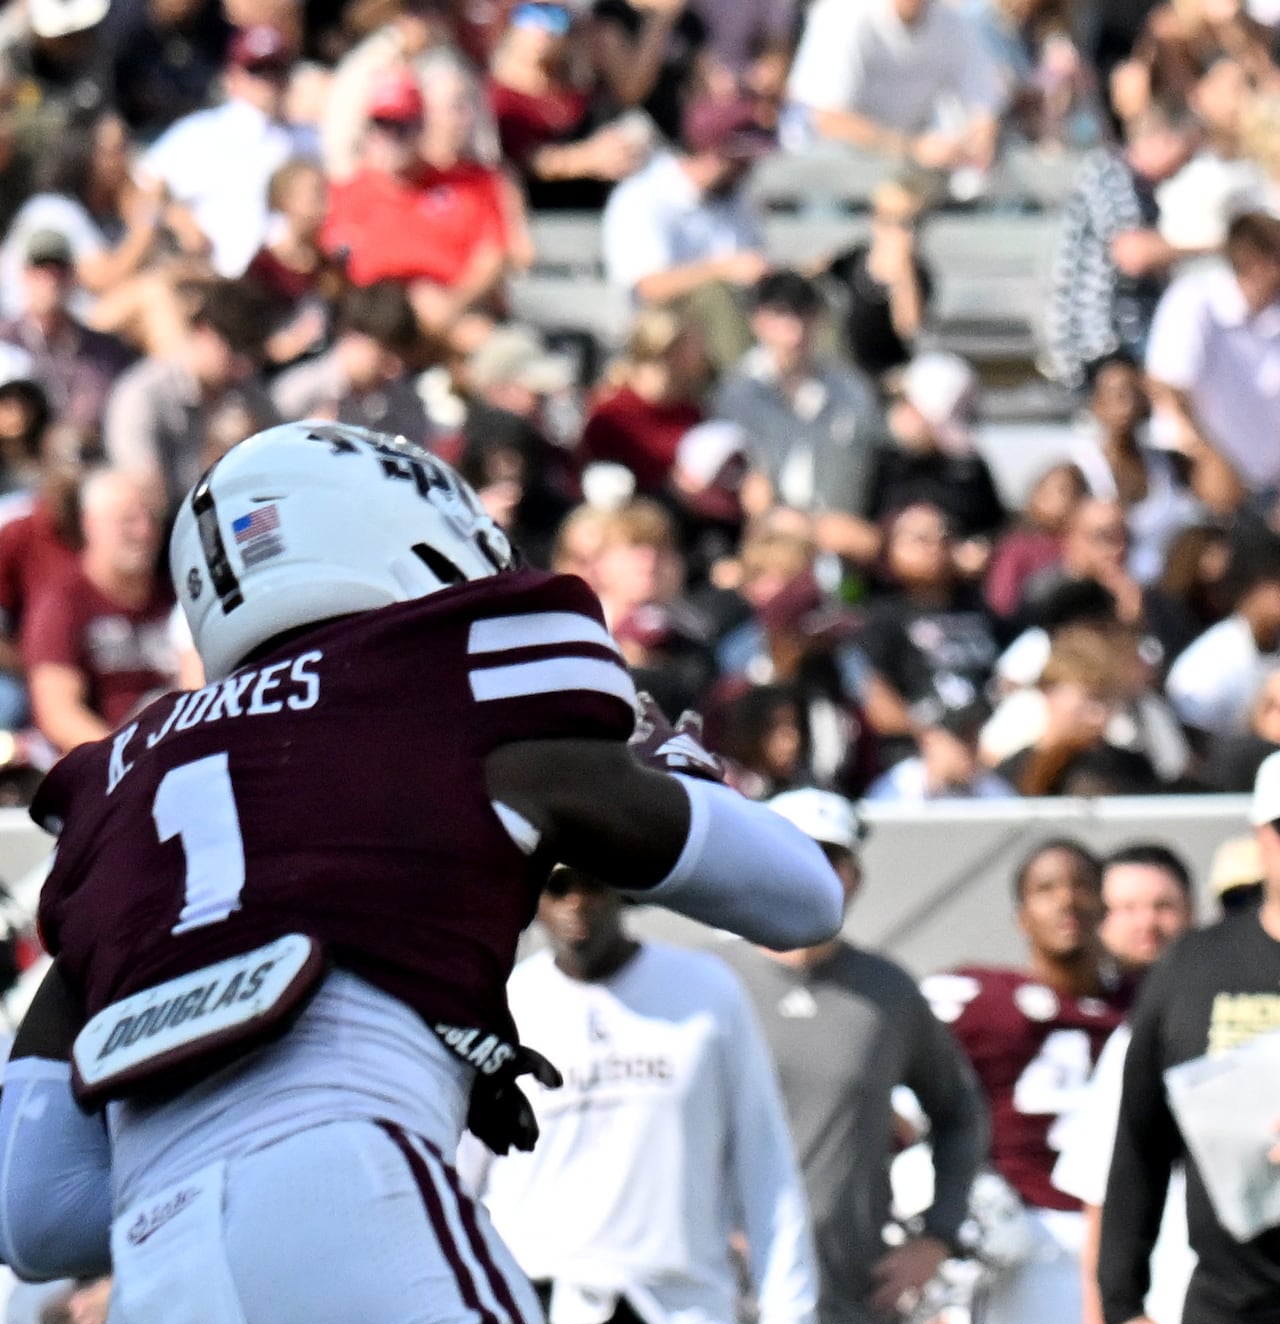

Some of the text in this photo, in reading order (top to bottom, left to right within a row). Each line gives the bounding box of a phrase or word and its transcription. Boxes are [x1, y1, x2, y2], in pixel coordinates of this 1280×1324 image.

[146, 650, 323, 749] JONES
[151, 750, 246, 937] 1
[98, 960, 273, 1060] DOUGLAS
